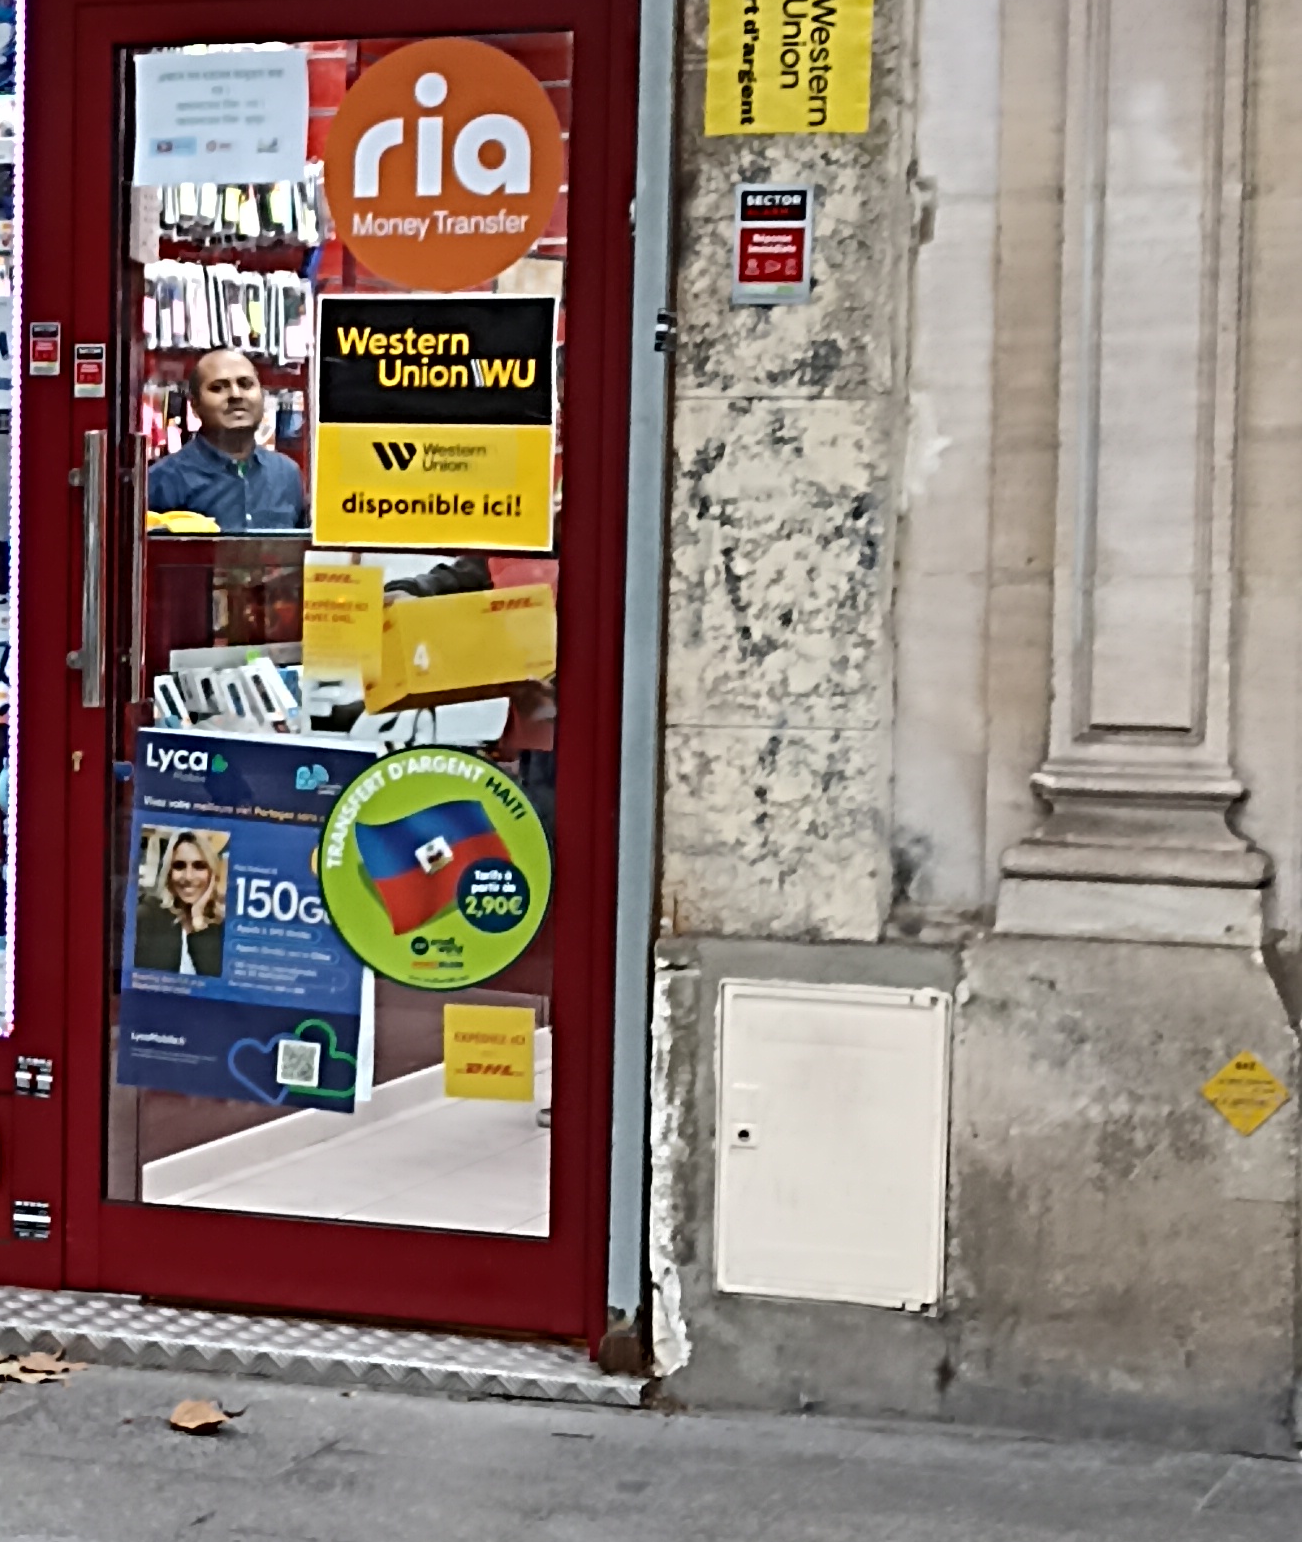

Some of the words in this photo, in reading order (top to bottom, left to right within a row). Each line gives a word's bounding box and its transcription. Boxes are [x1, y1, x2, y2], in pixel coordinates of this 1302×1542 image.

[737, 21, 760, 127] d'argent
[353, 72, 531, 198] ria
[746, 195, 802, 207] SECTOR
[352, 212, 430, 241] Money
[433, 208, 529, 234] Transfer
[337, 327, 470, 356] Western
[379, 358, 469, 388] Union
[483, 358, 537, 389] WU
[422, 442, 487, 458] Western
[422, 457, 469, 473] Union
[341, 492, 475, 518] disponible
[482, 493, 522, 517] ici!
[491, 596, 532, 612] DHL
[145, 743, 209, 773] Lyca
[326, 769, 386, 870] TRANSFERT
[387, 755, 486, 784] D'ARGENT
[465, 895, 523, 918] 2,90€
[464, 1062, 514, 1077] DHL
